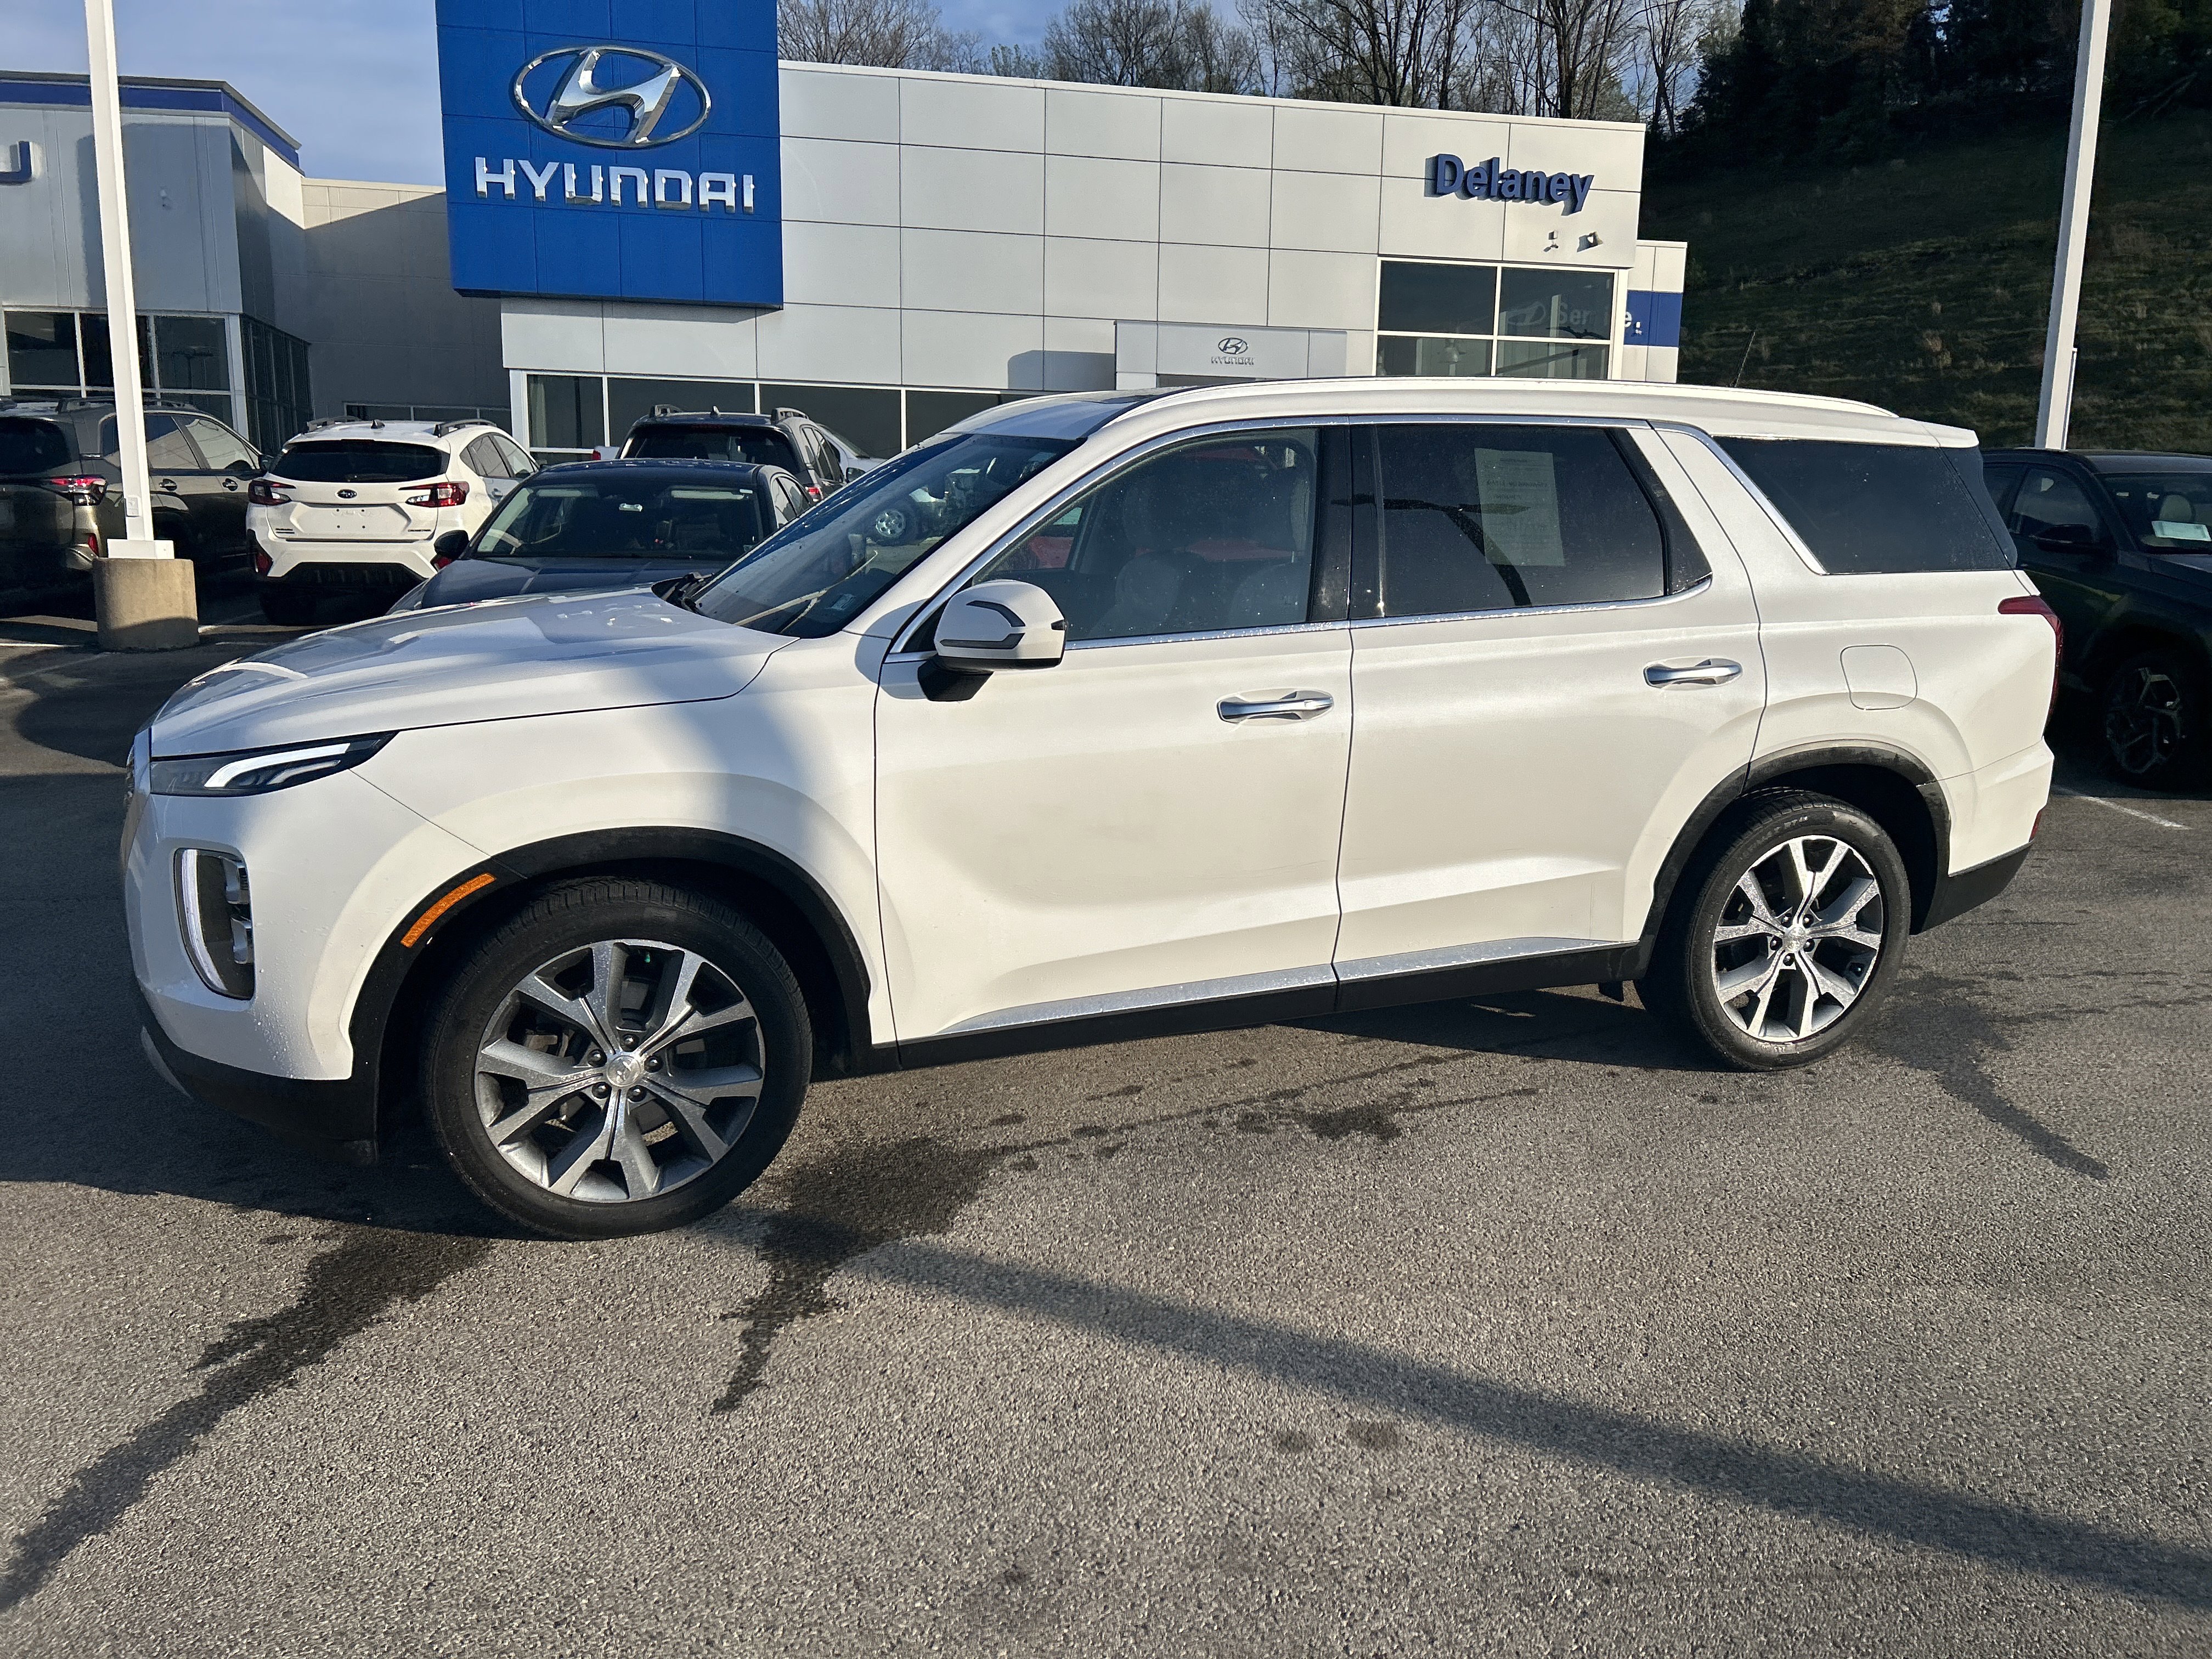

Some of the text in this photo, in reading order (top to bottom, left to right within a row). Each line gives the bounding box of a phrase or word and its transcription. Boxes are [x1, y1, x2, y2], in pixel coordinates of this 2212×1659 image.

[475, 156, 754, 214] HYUNDAI
[1435, 154, 1594, 213] Delaney
[1211, 356, 1254, 365] HYUNDAI
